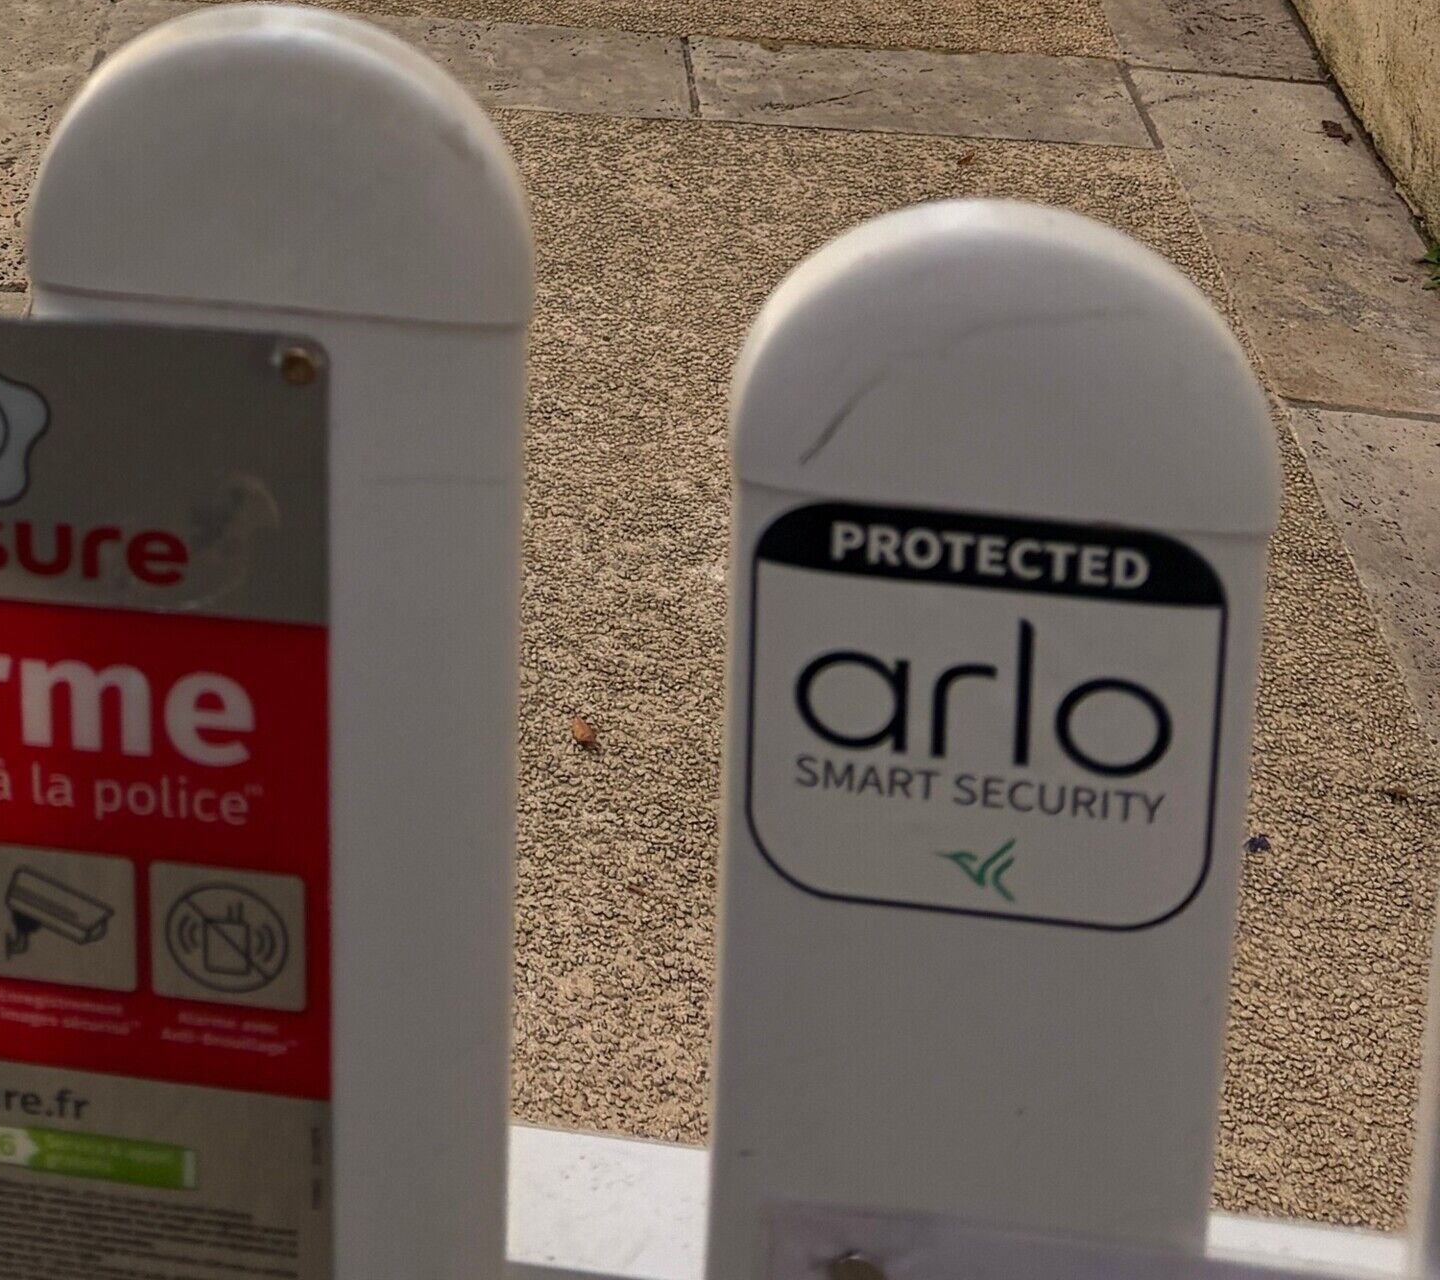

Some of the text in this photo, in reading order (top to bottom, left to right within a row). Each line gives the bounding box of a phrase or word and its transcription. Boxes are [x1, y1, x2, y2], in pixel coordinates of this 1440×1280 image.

[829, 519, 1152, 591] PROTECTED
[794, 617, 1172, 778] arlo
[31, 761, 74, 808] la
[796, 755, 1166, 825] SMART SECURITY
